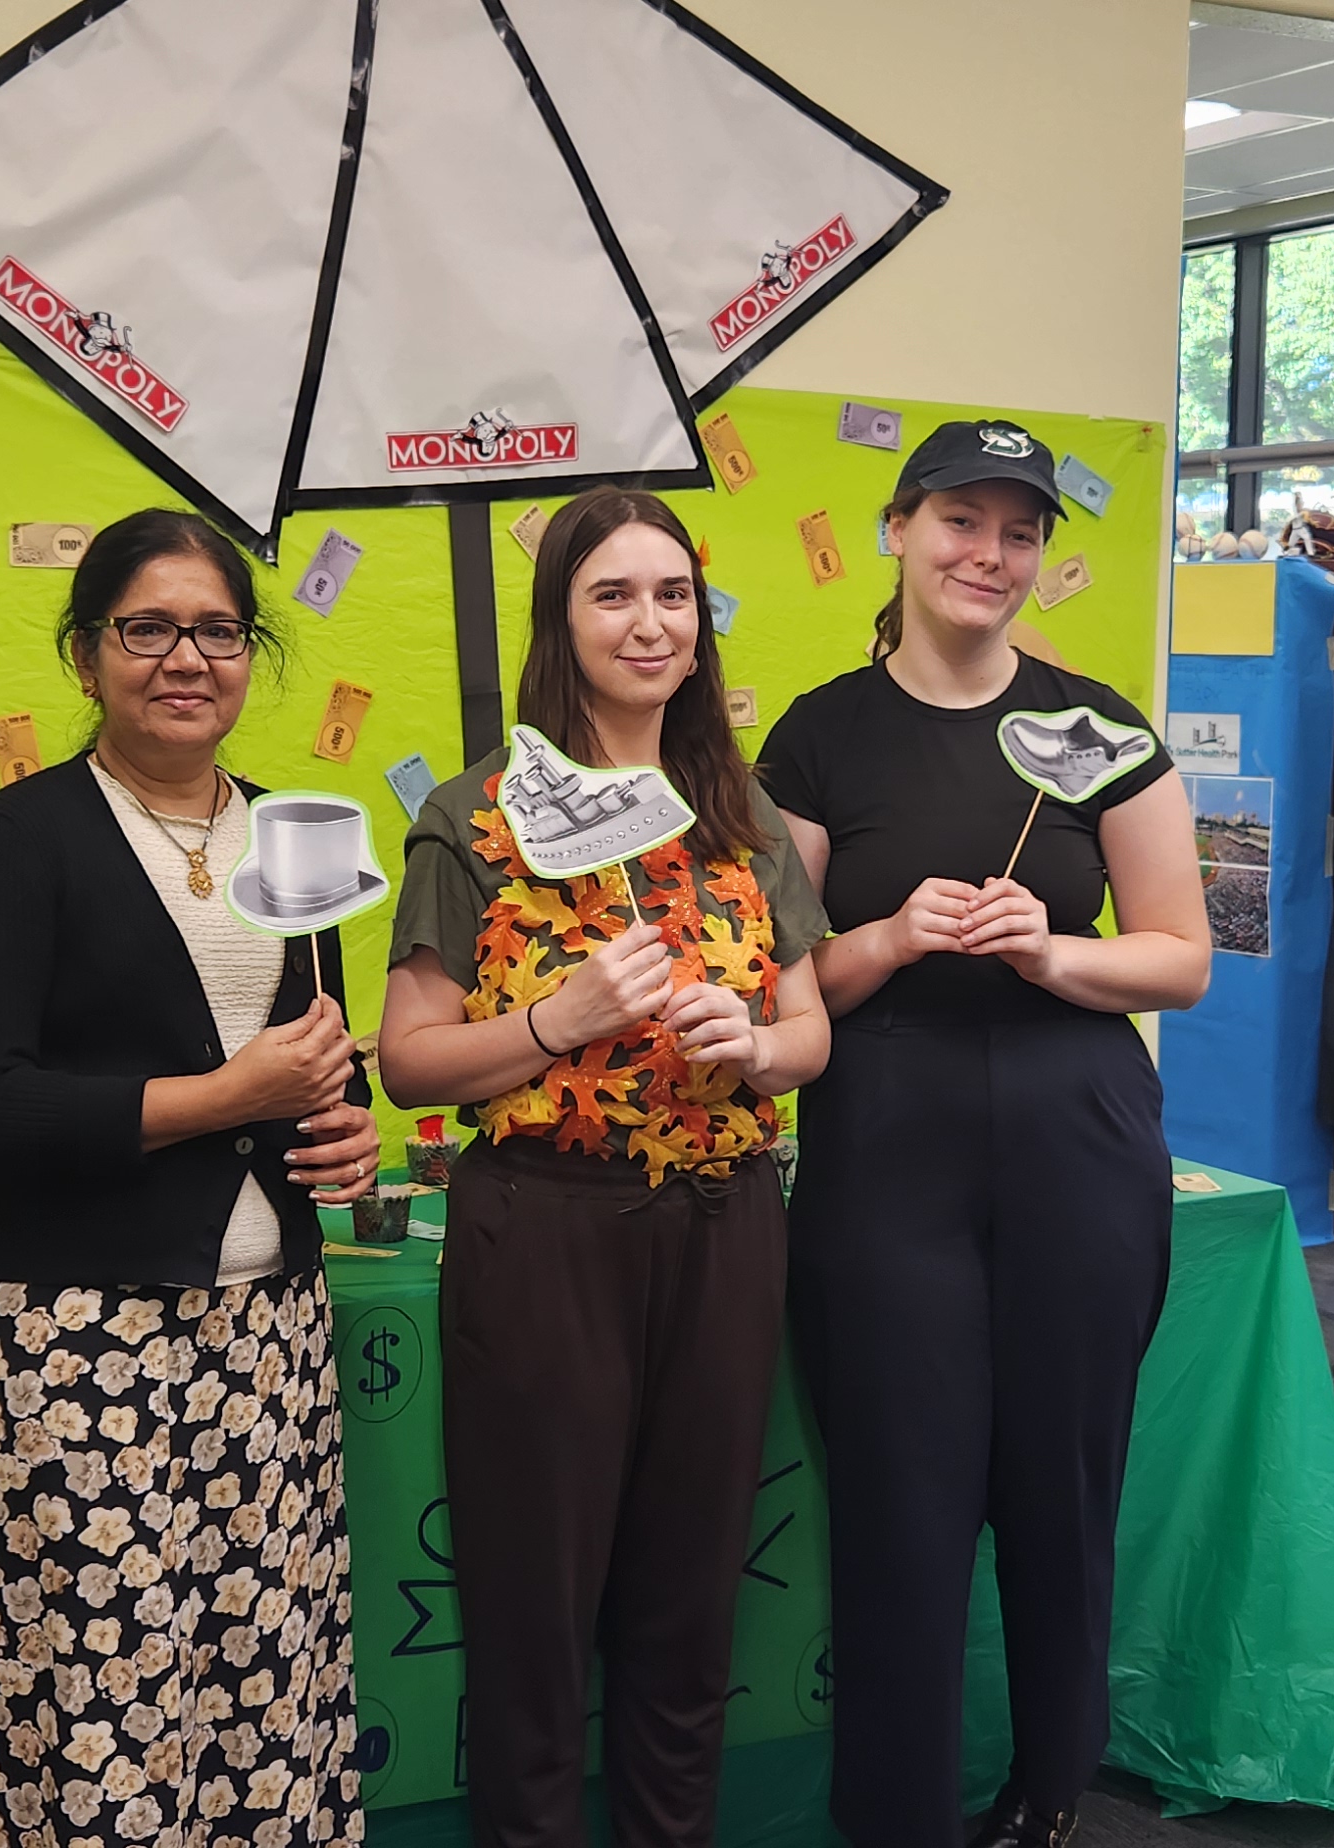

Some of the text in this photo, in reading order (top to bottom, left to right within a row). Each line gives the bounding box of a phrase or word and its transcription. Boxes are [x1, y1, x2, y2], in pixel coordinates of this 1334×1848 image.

[715, 221, 846, 344] MONOPOLY
[391, 429, 572, 466] MONOPOLY
[1198, 748, 1220, 758] Health
[1221, 750, 1238, 759] Park
